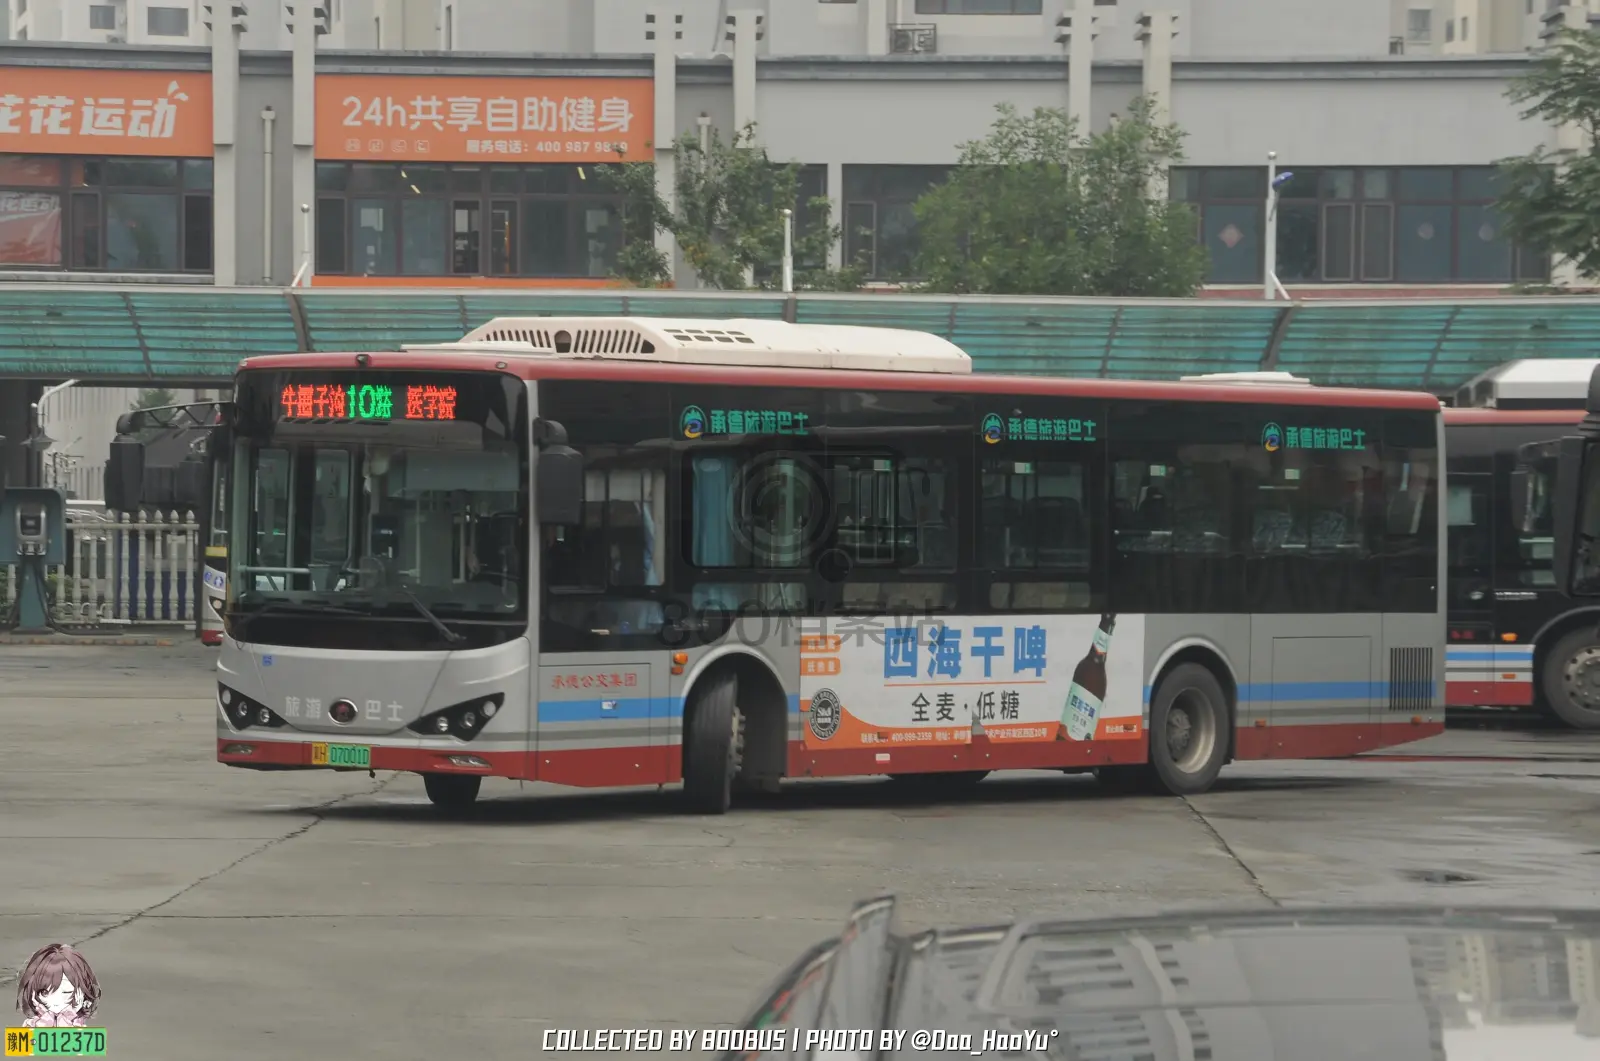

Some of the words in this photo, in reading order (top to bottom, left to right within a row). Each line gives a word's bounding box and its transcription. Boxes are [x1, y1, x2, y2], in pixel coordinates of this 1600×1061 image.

[342, 95, 634, 133] 24h共享自助健身
[536, 141, 561, 153] 400
[405, 385, 457, 420] 医学院
[711, 409, 809, 436] 承德旅游巴士
[1008, 417, 1097, 442] 承德旅游巴士
[1286, 426, 1366, 450] 承德旅游巴士
[884, 625, 1047, 679] 四海干啤
[552, 672, 637, 689] 承德公交集团
[285, 696, 322, 719] 旅游
[365, 699, 403, 722] 巴士
